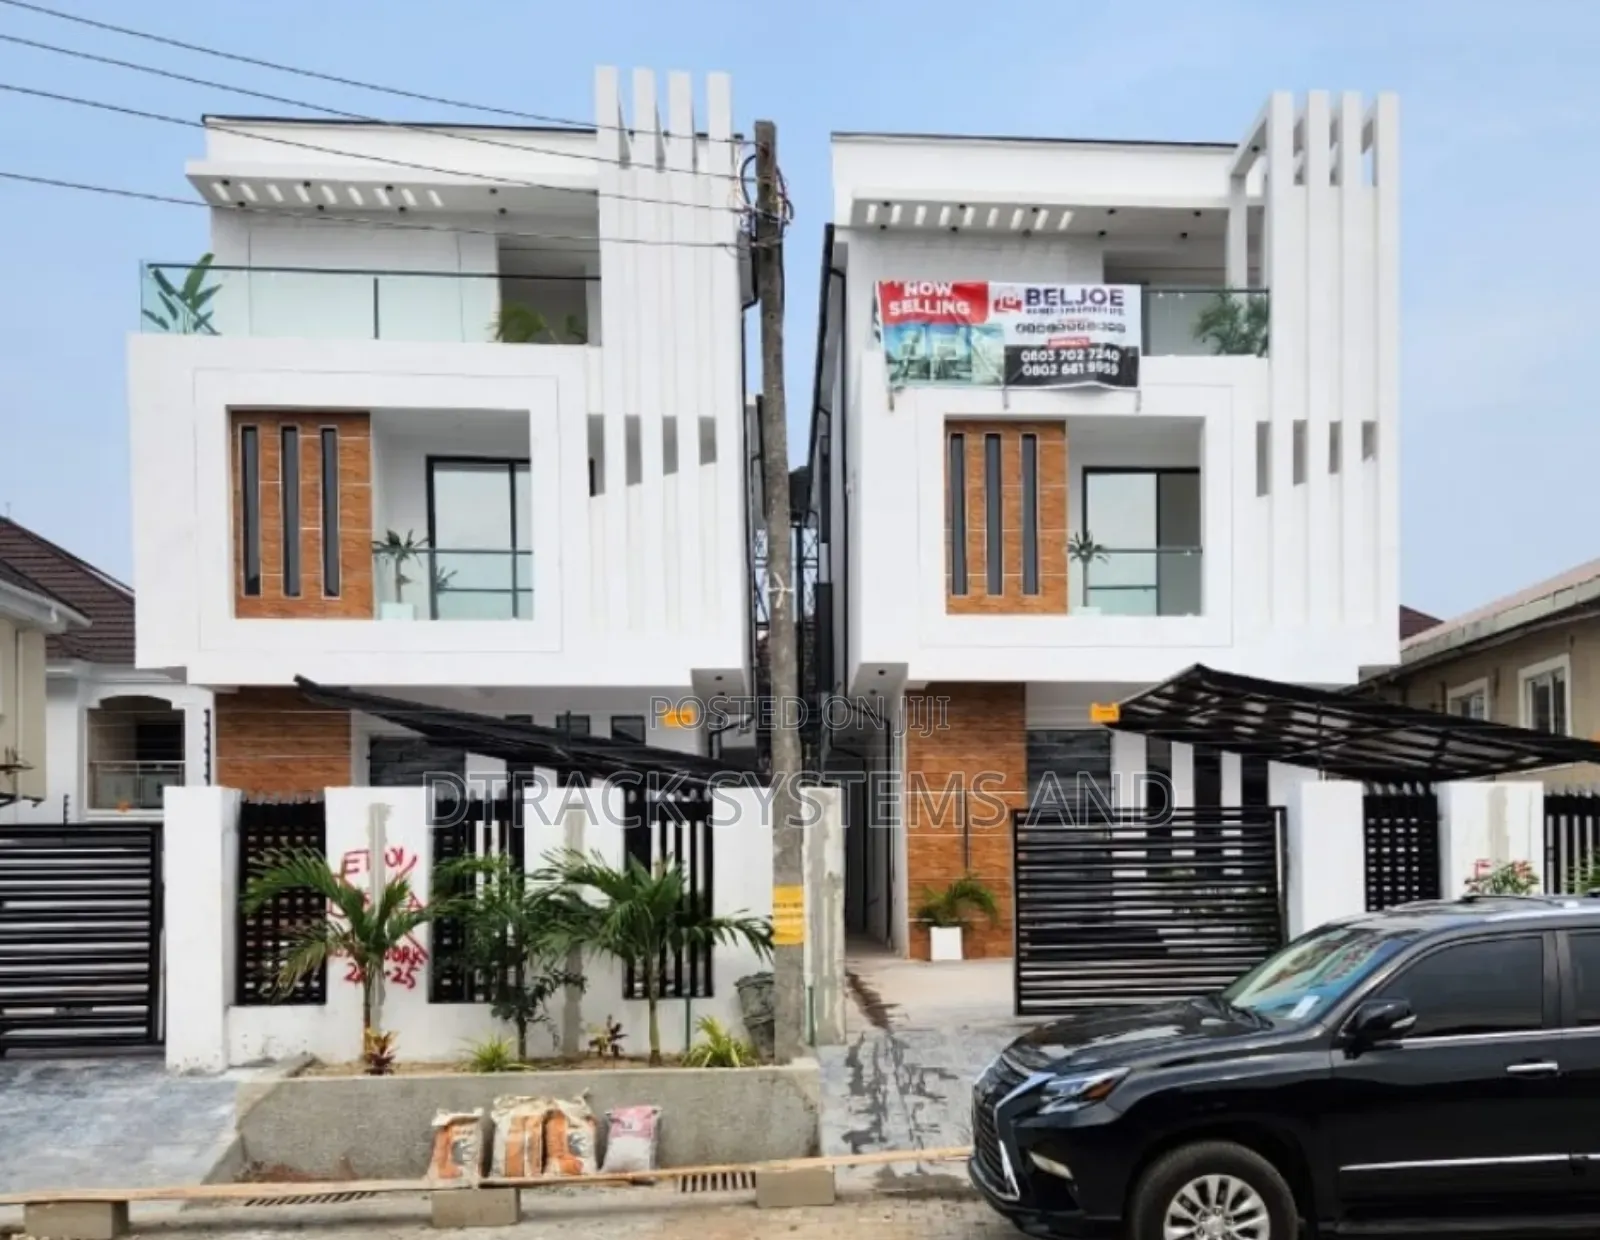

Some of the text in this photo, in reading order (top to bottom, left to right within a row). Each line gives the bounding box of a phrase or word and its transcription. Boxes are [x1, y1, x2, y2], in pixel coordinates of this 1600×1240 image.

[903, 280, 953, 297] NOW
[1025, 287, 1125, 306] BELJOE
[888, 298, 971, 316] SELLING
